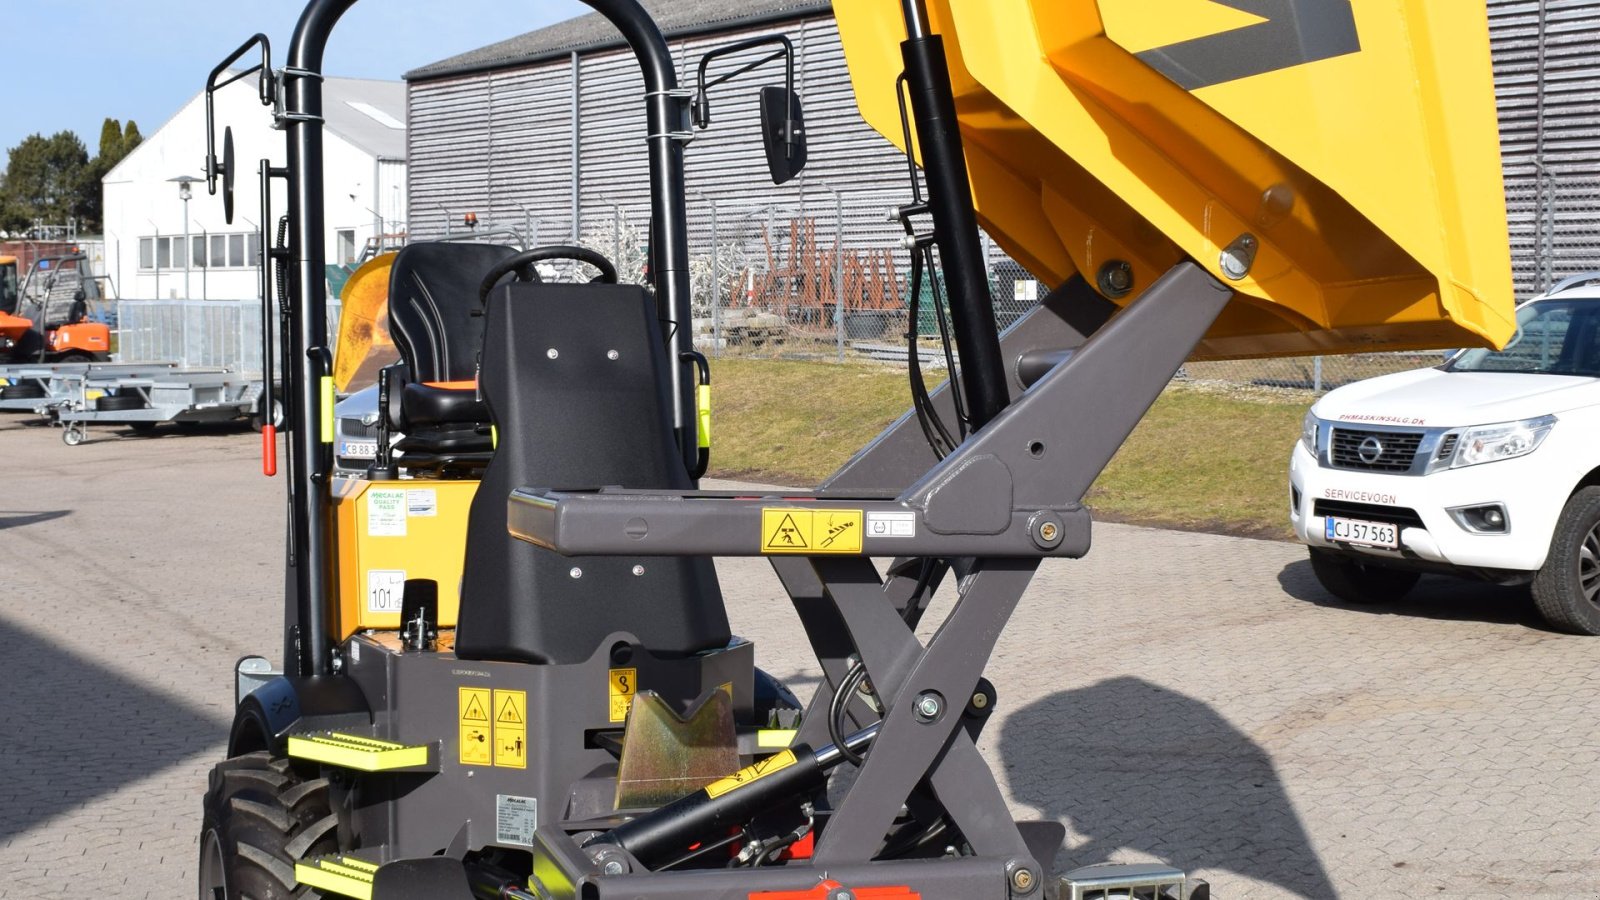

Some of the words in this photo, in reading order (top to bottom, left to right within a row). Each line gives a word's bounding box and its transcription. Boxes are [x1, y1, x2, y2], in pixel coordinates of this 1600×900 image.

[346, 445, 357, 454] CB
[359, 445, 369, 455] 88
[1324, 488, 1397, 504] SERVICEVOGN
[1335, 522, 1350, 537] CJ
[1353, 524, 1368, 540] 57
[1371, 526, 1394, 544] 563
[372, 588, 391, 609] 101
